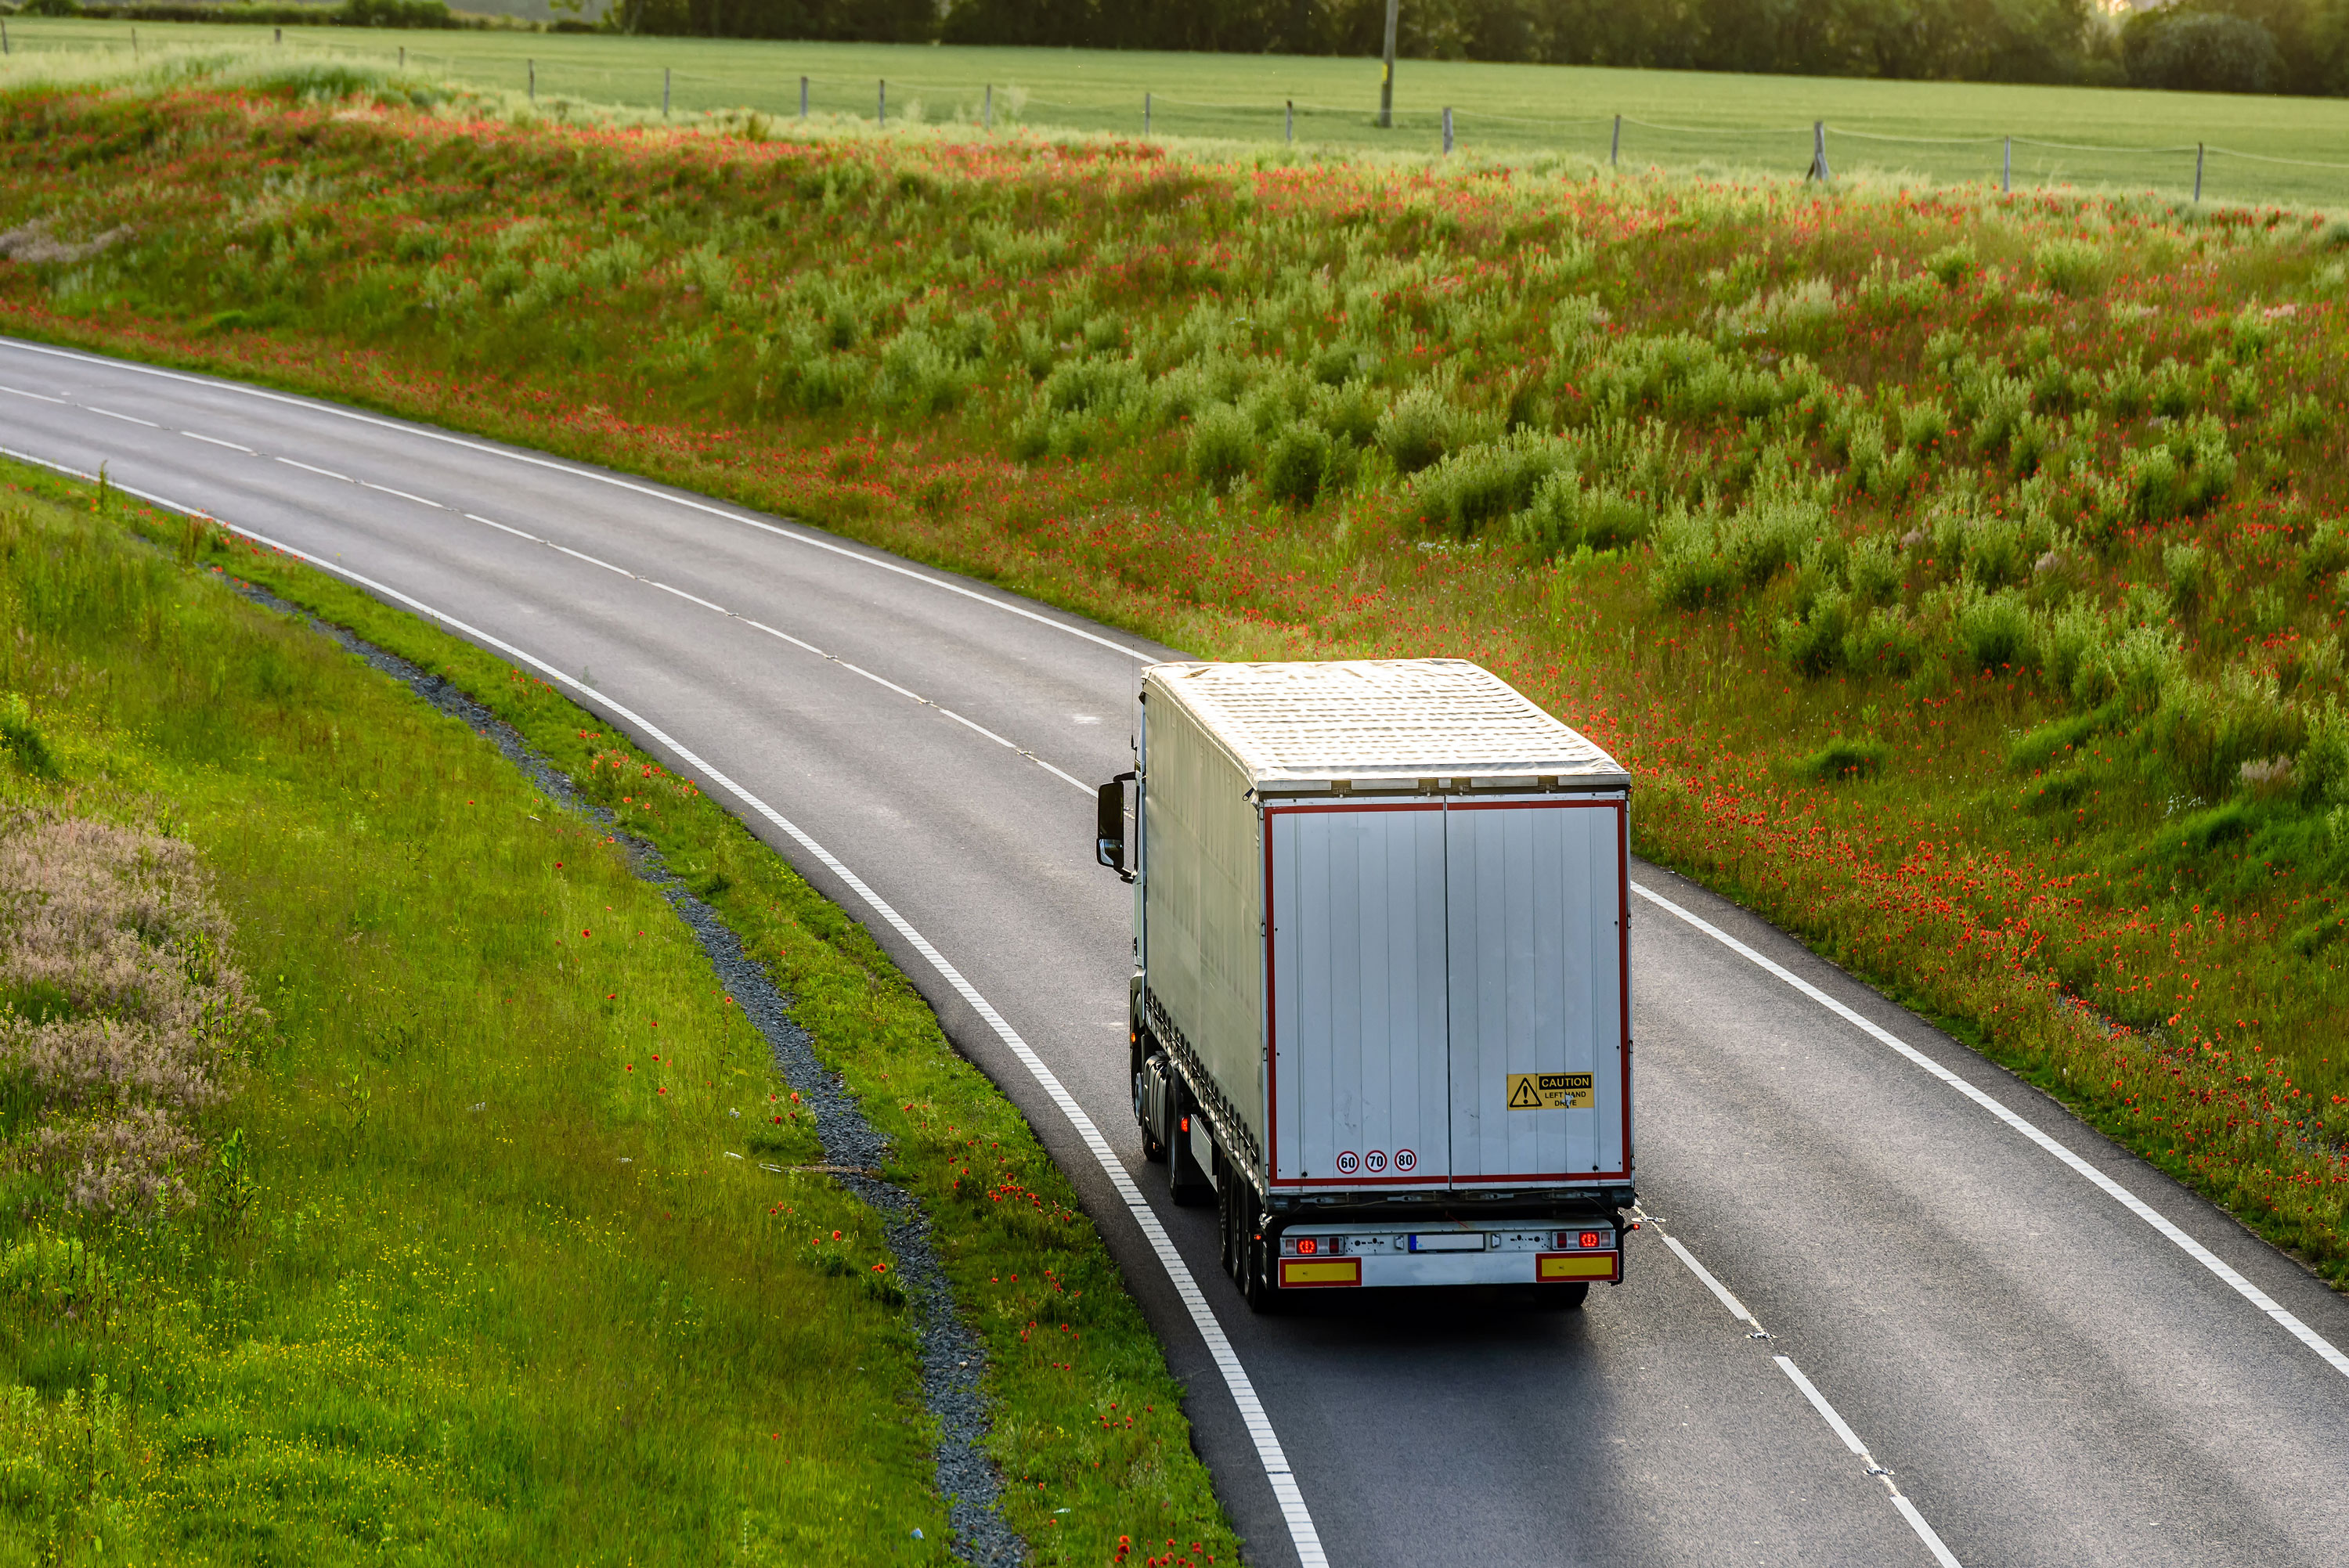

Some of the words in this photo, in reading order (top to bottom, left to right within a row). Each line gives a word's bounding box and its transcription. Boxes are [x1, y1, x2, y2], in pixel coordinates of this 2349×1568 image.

[1542, 1077, 1589, 1088] CAUTION
[1340, 1157, 1355, 1169] 60
[1369, 1155, 1384, 1167] 70
[1398, 1155, 1413, 1166] 80
